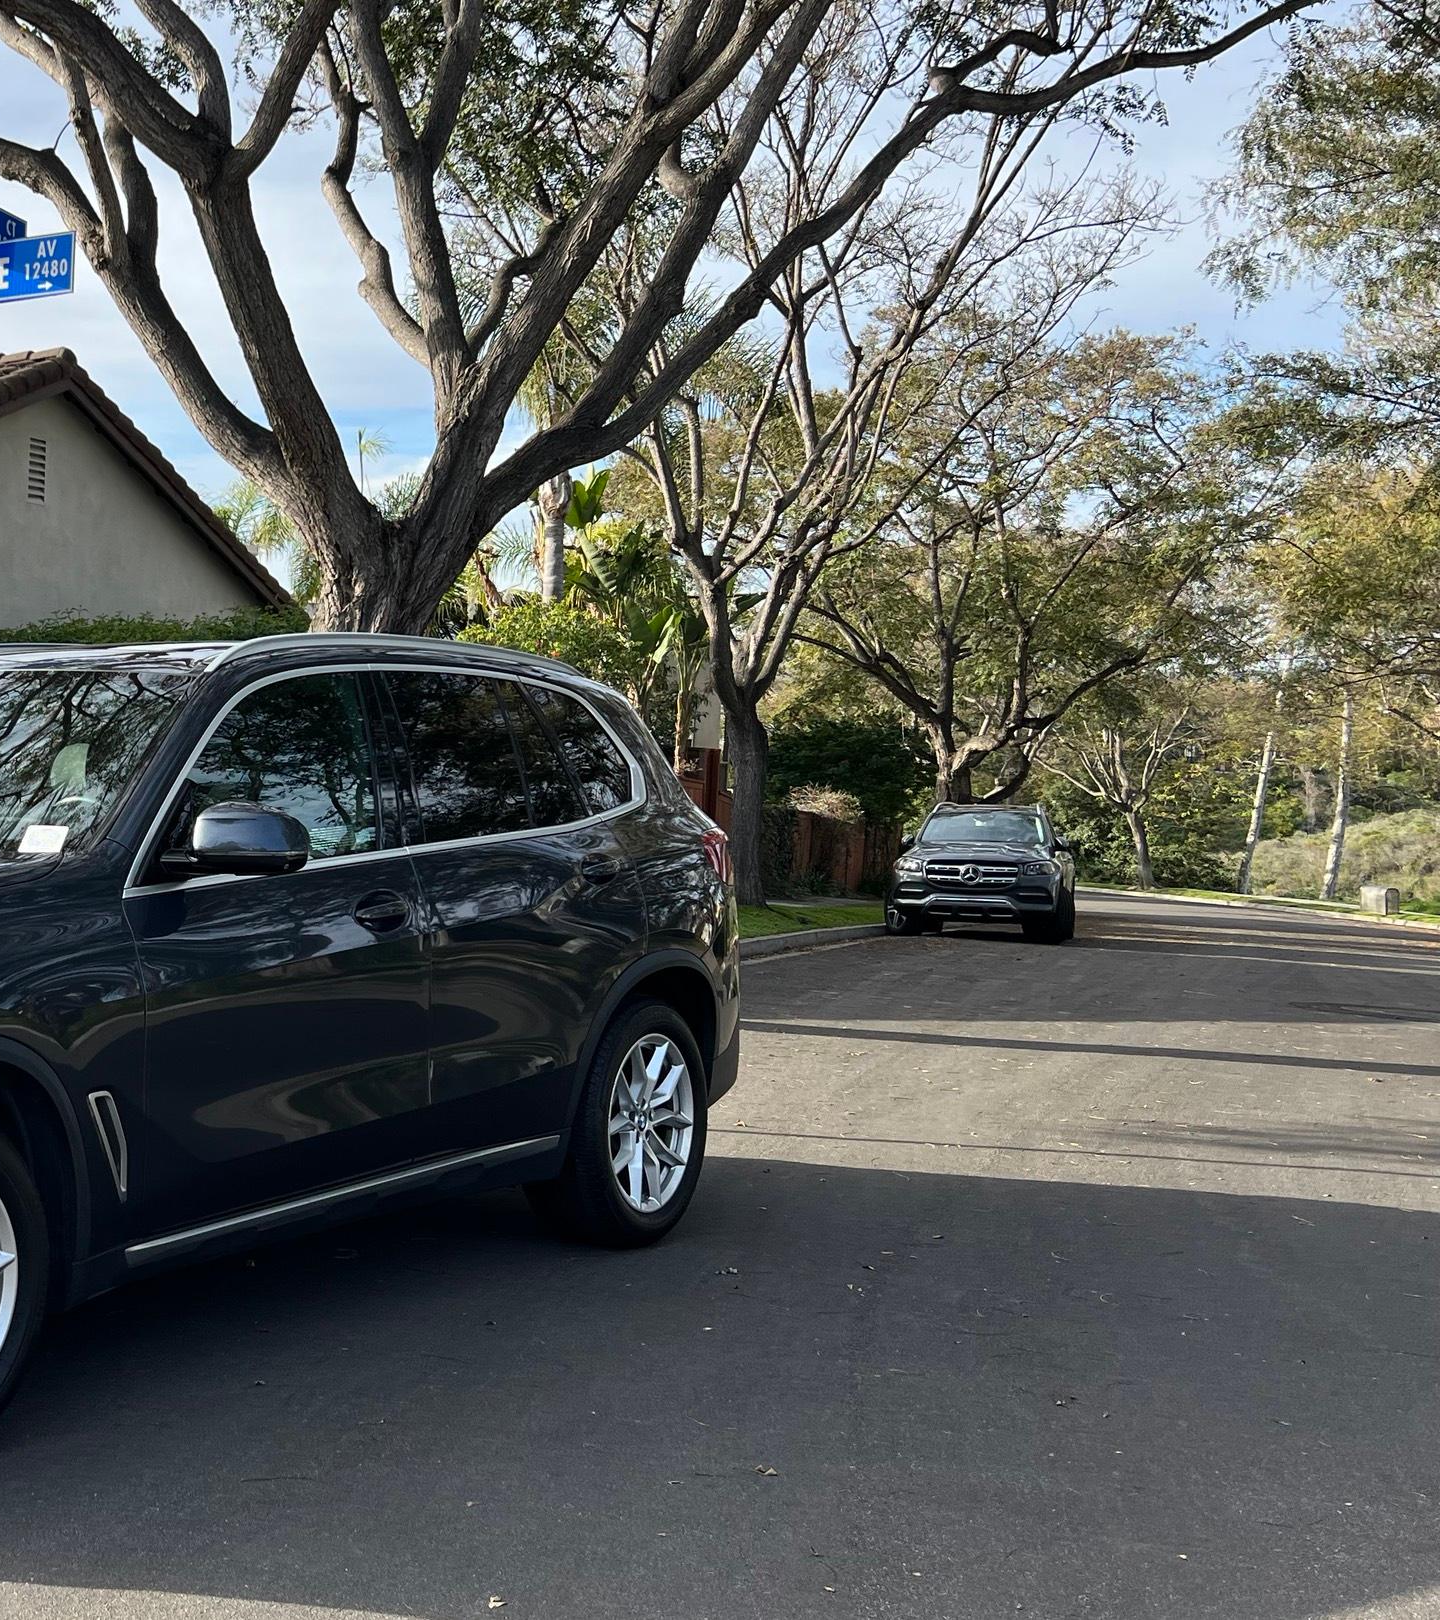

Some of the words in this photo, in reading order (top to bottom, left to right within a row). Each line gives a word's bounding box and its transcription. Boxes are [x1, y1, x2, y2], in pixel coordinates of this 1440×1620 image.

[6, 219, 16, 238] CT
[36, 239, 57, 259] AV
[24, 258, 68, 281] 12480
